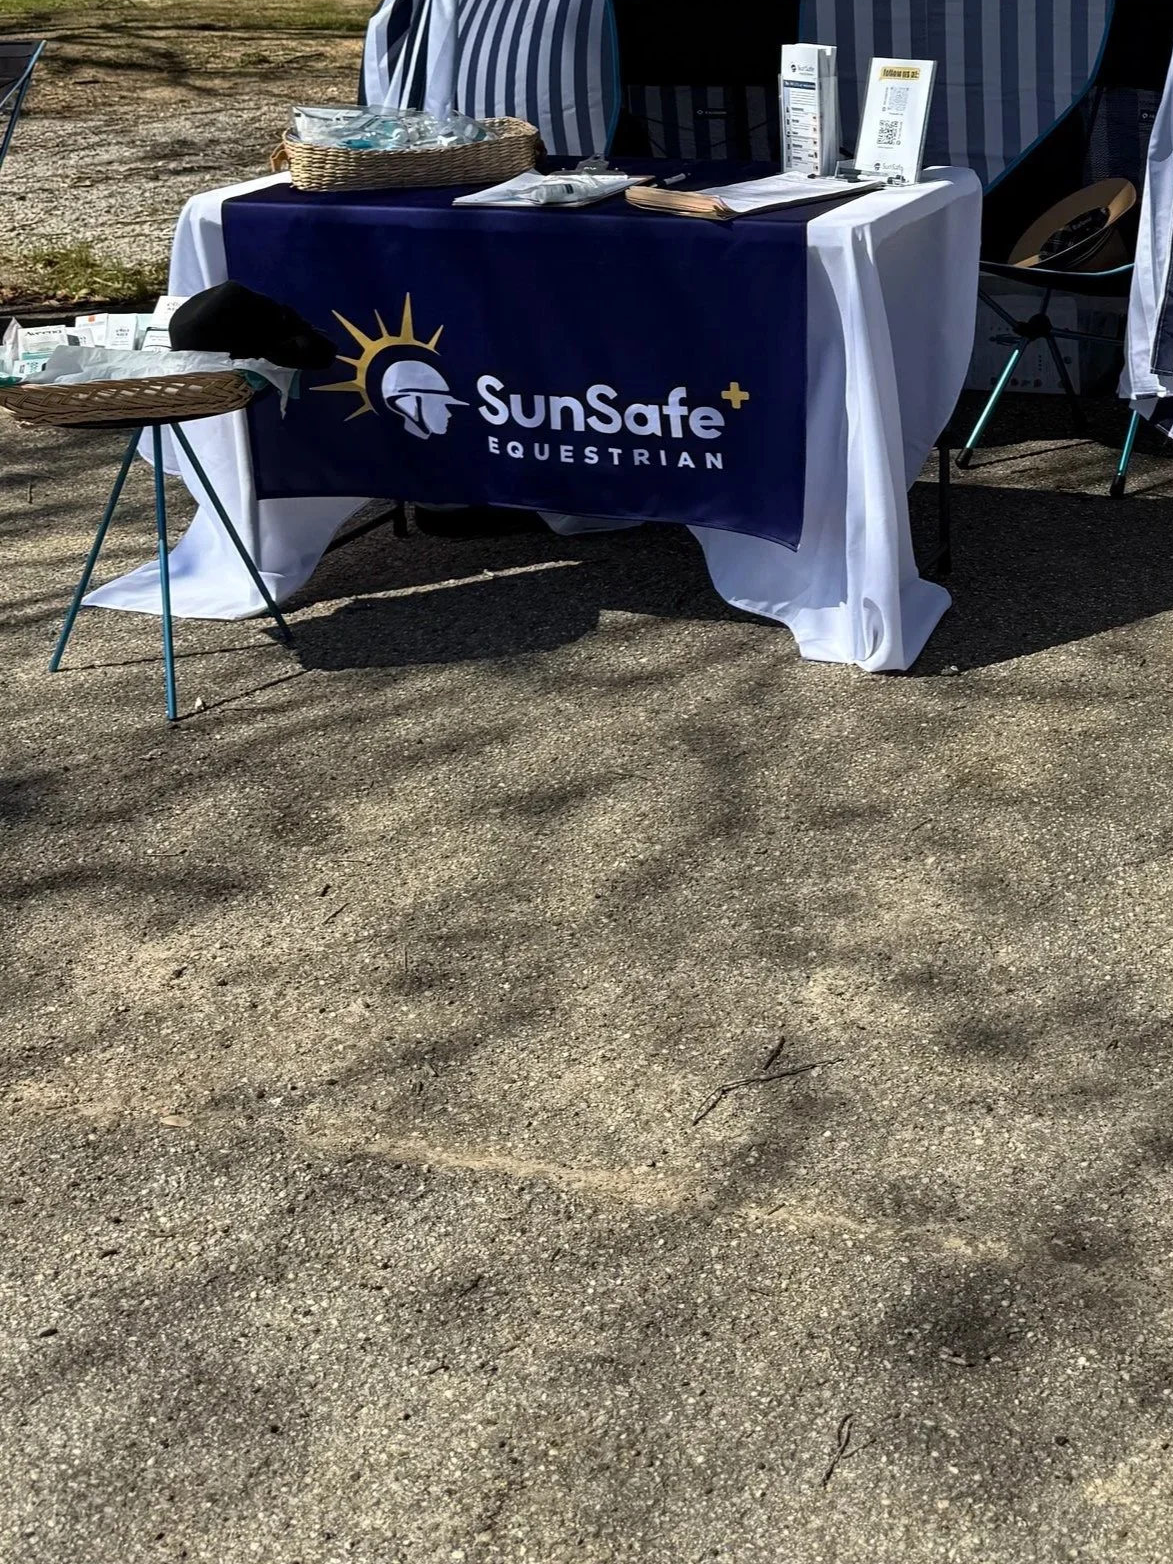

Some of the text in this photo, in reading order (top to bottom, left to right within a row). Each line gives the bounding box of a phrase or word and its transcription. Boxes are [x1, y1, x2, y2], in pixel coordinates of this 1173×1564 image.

[882, 68, 902, 78] follow
[902, 70, 910, 78] us
[488, 436, 723, 470] EQUESTRIAN
